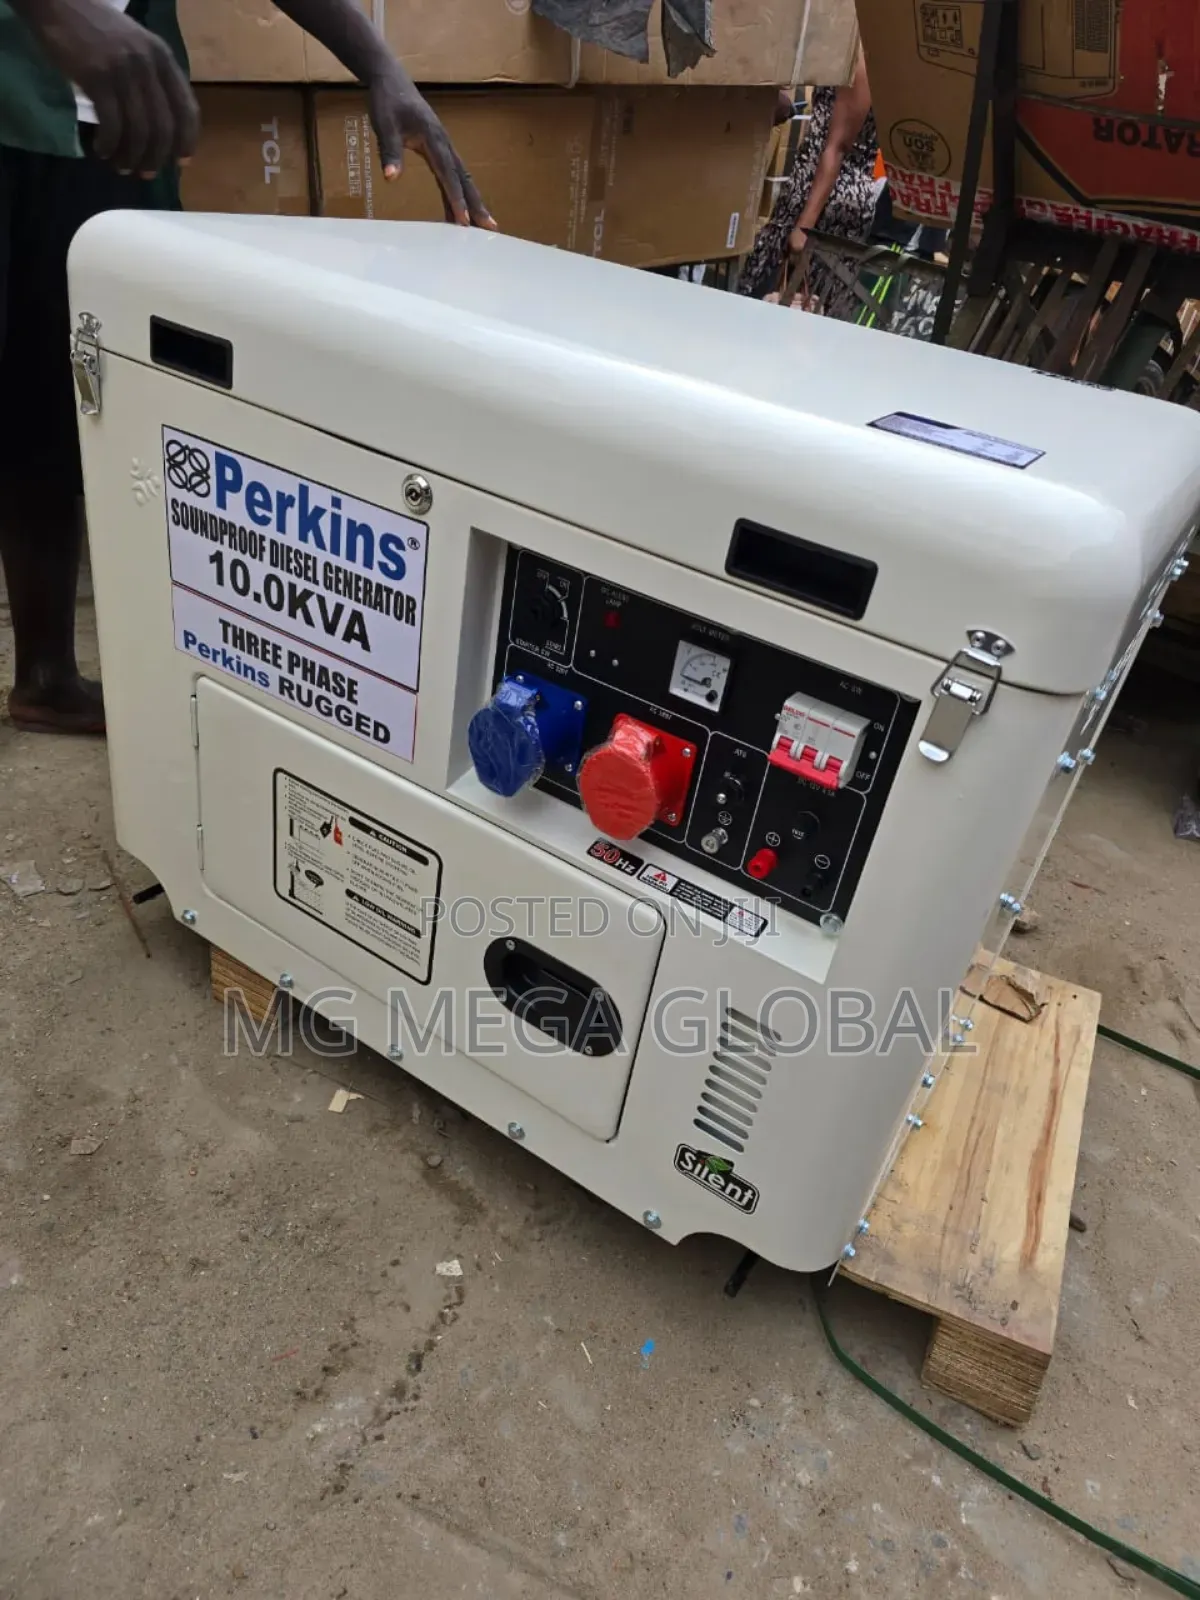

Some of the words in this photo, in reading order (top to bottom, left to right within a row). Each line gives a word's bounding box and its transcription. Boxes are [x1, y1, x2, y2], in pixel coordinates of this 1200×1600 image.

[260, 116, 280, 184] TCL
[214, 451, 407, 581] Perkins
[171, 498, 266, 562] SOUNDPROOF
[269, 538, 319, 585] DIESEL
[323, 561, 416, 627] GENERATOR
[209, 551, 371, 652] 10.0KVA
[183, 630, 270, 688] Perkins
[278, 675, 390, 744] RUGGED
[219, 618, 282, 669] THREE
[287, 649, 358, 705] PHASE
[873, 721, 885, 733] ON
[855, 770, 871, 781] OFF
[378, 834, 408, 853] CAUTION
[591, 841, 637, 875] 50Hz
[680, 1151, 753, 1206] Silent
